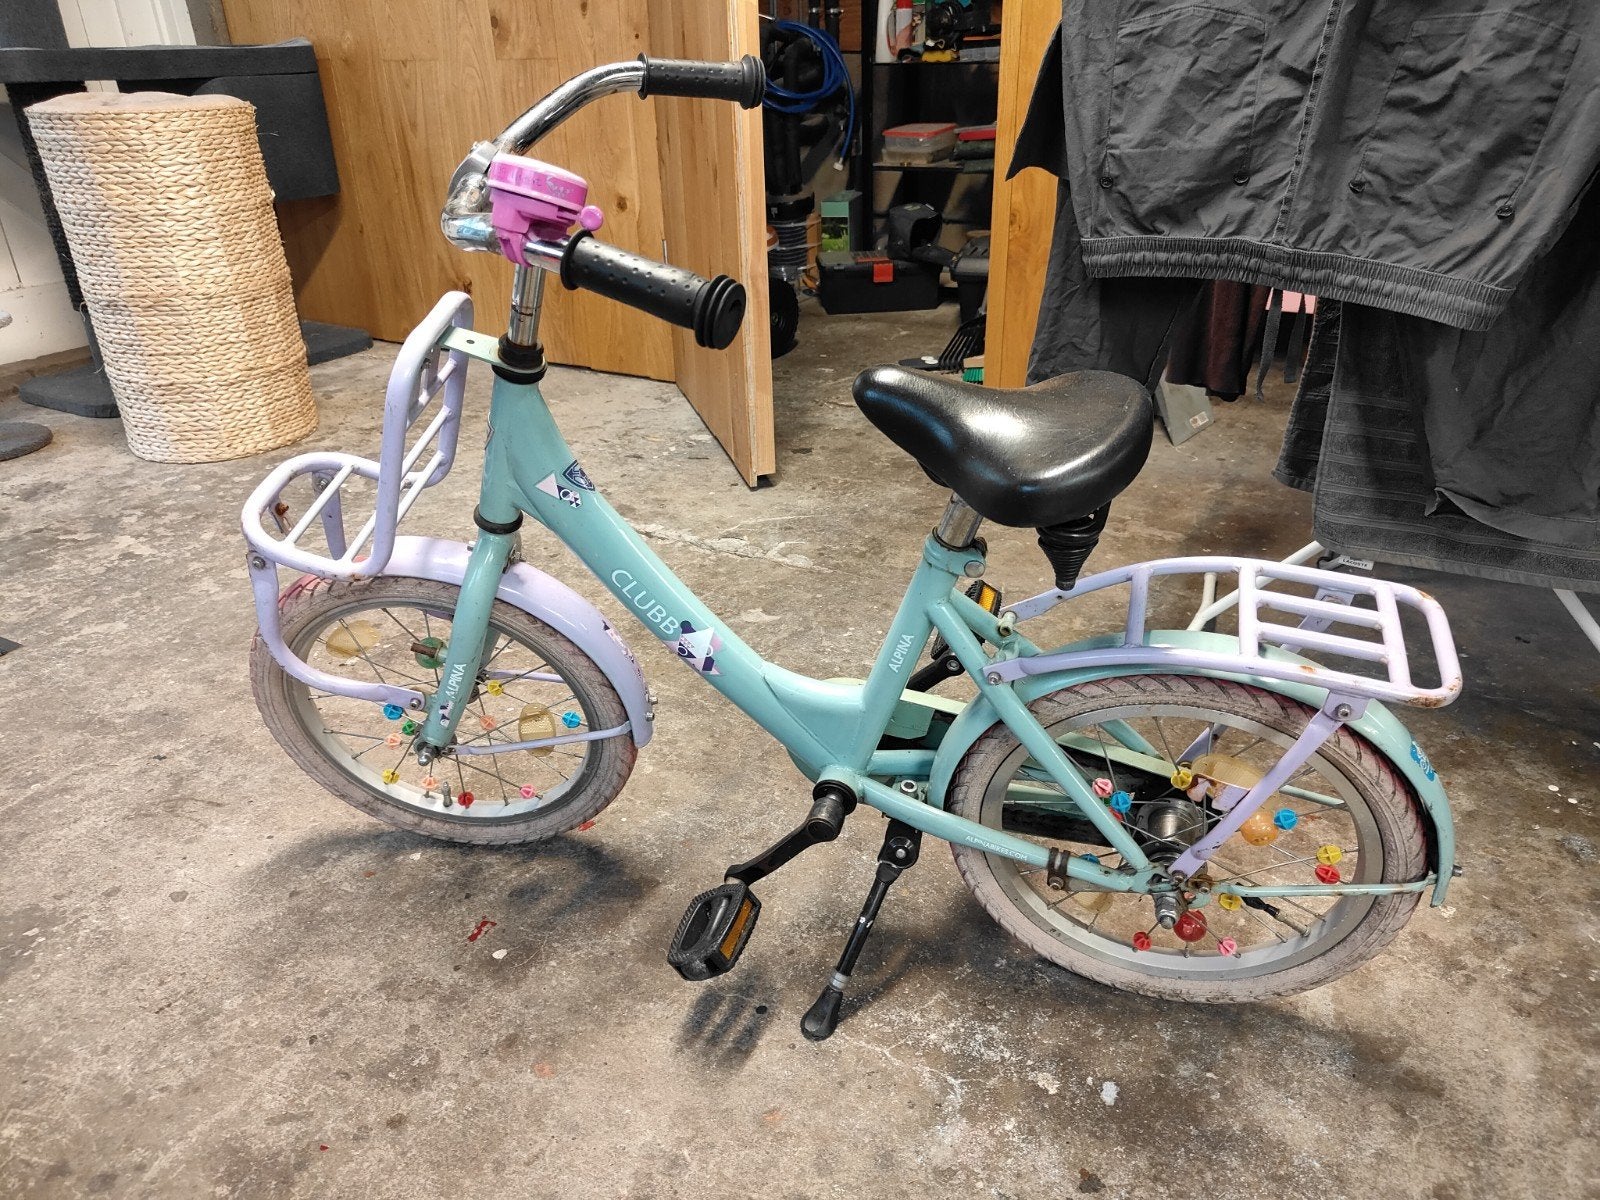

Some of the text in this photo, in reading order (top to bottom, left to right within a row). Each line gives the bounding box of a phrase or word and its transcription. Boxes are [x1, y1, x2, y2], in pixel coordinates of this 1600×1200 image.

[611, 569, 680, 635] CLUBB
[888, 633, 915, 673] ALPINA
[445, 663, 467, 699] ALPINA
